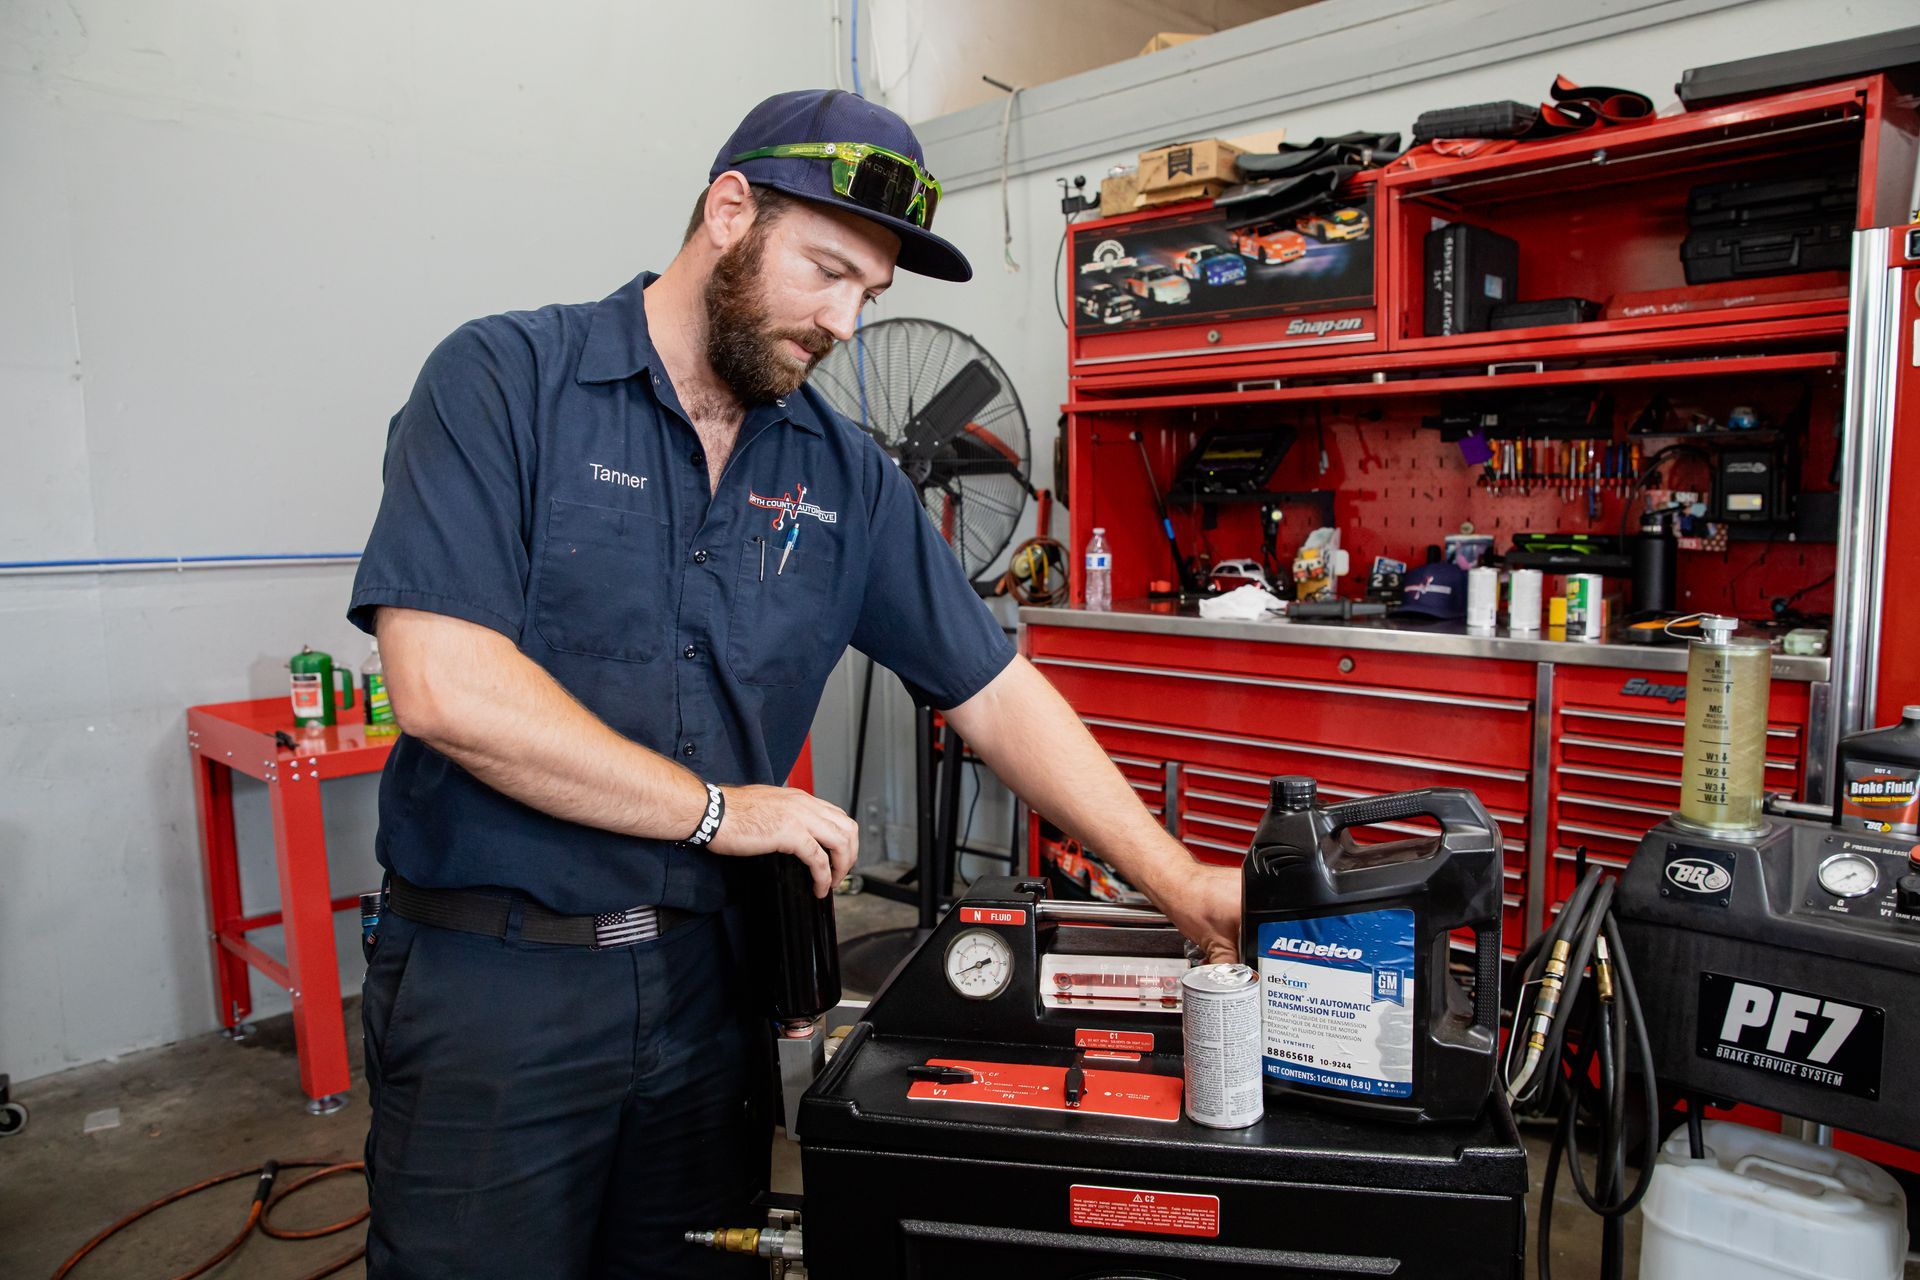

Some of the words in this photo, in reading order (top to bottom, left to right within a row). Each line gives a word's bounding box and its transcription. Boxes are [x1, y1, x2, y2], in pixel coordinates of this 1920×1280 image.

[589, 462, 648, 489] Tanner
[1708, 704, 1723, 713] MC
[1706, 752, 1719, 760] W1
[1705, 767, 1719, 777] W2
[1704, 782, 1718, 792] W3
[1851, 781, 1883, 794] Brake
[1884, 781, 1914, 794] Fluid
[1704, 793, 1718, 802] W4
[1851, 844, 1881, 854] PRESSURE
[1882, 848, 1908, 857] RELEASE
[1670, 863, 1709, 885] BG
[1828, 905, 1849, 913] GAUGE
[1837, 899, 1845, 907] G
[974, 910, 981, 921] N
[990, 913, 1012, 922] FLUID
[1880, 908, 1892, 917] V1
[1271, 936, 1363, 961] ACDelco
[1267, 974, 1308, 990] dexron
[1378, 974, 1398, 990] GM
[1267, 1000, 1330, 1016] TRANSMISSION
[1331, 1009, 1356, 1020] FLUID
[1320, 999, 1371, 1012] AUTOMATIC
[1327, 1018, 1367, 1029] TRANSMISSION
[1719, 981, 1864, 1065] PF7
[1109, 1032, 1118, 1040] C1
[1338, 1026, 1359, 1034] MOTOR
[1267, 1036, 1281, 1044] FULL
[1283, 1039, 1315, 1050] SYNTHETIC
[1267, 1046, 1314, 1063] 88865618
[1320, 1058, 1352, 1069] 10-9244
[1716, 1047, 1750, 1064] BRAKE
[1753, 1054, 1798, 1076] SERVICE
[1800, 1066, 1843, 1087] SYSTEM
[1267, 1064, 1280, 1074] NET
[1280, 1067, 1316, 1081] CONTENTS:
[1322, 1075, 1348, 1087] GALLON
[933, 1088, 948, 1097] V1
[1144, 1194, 1155, 1203] C2
